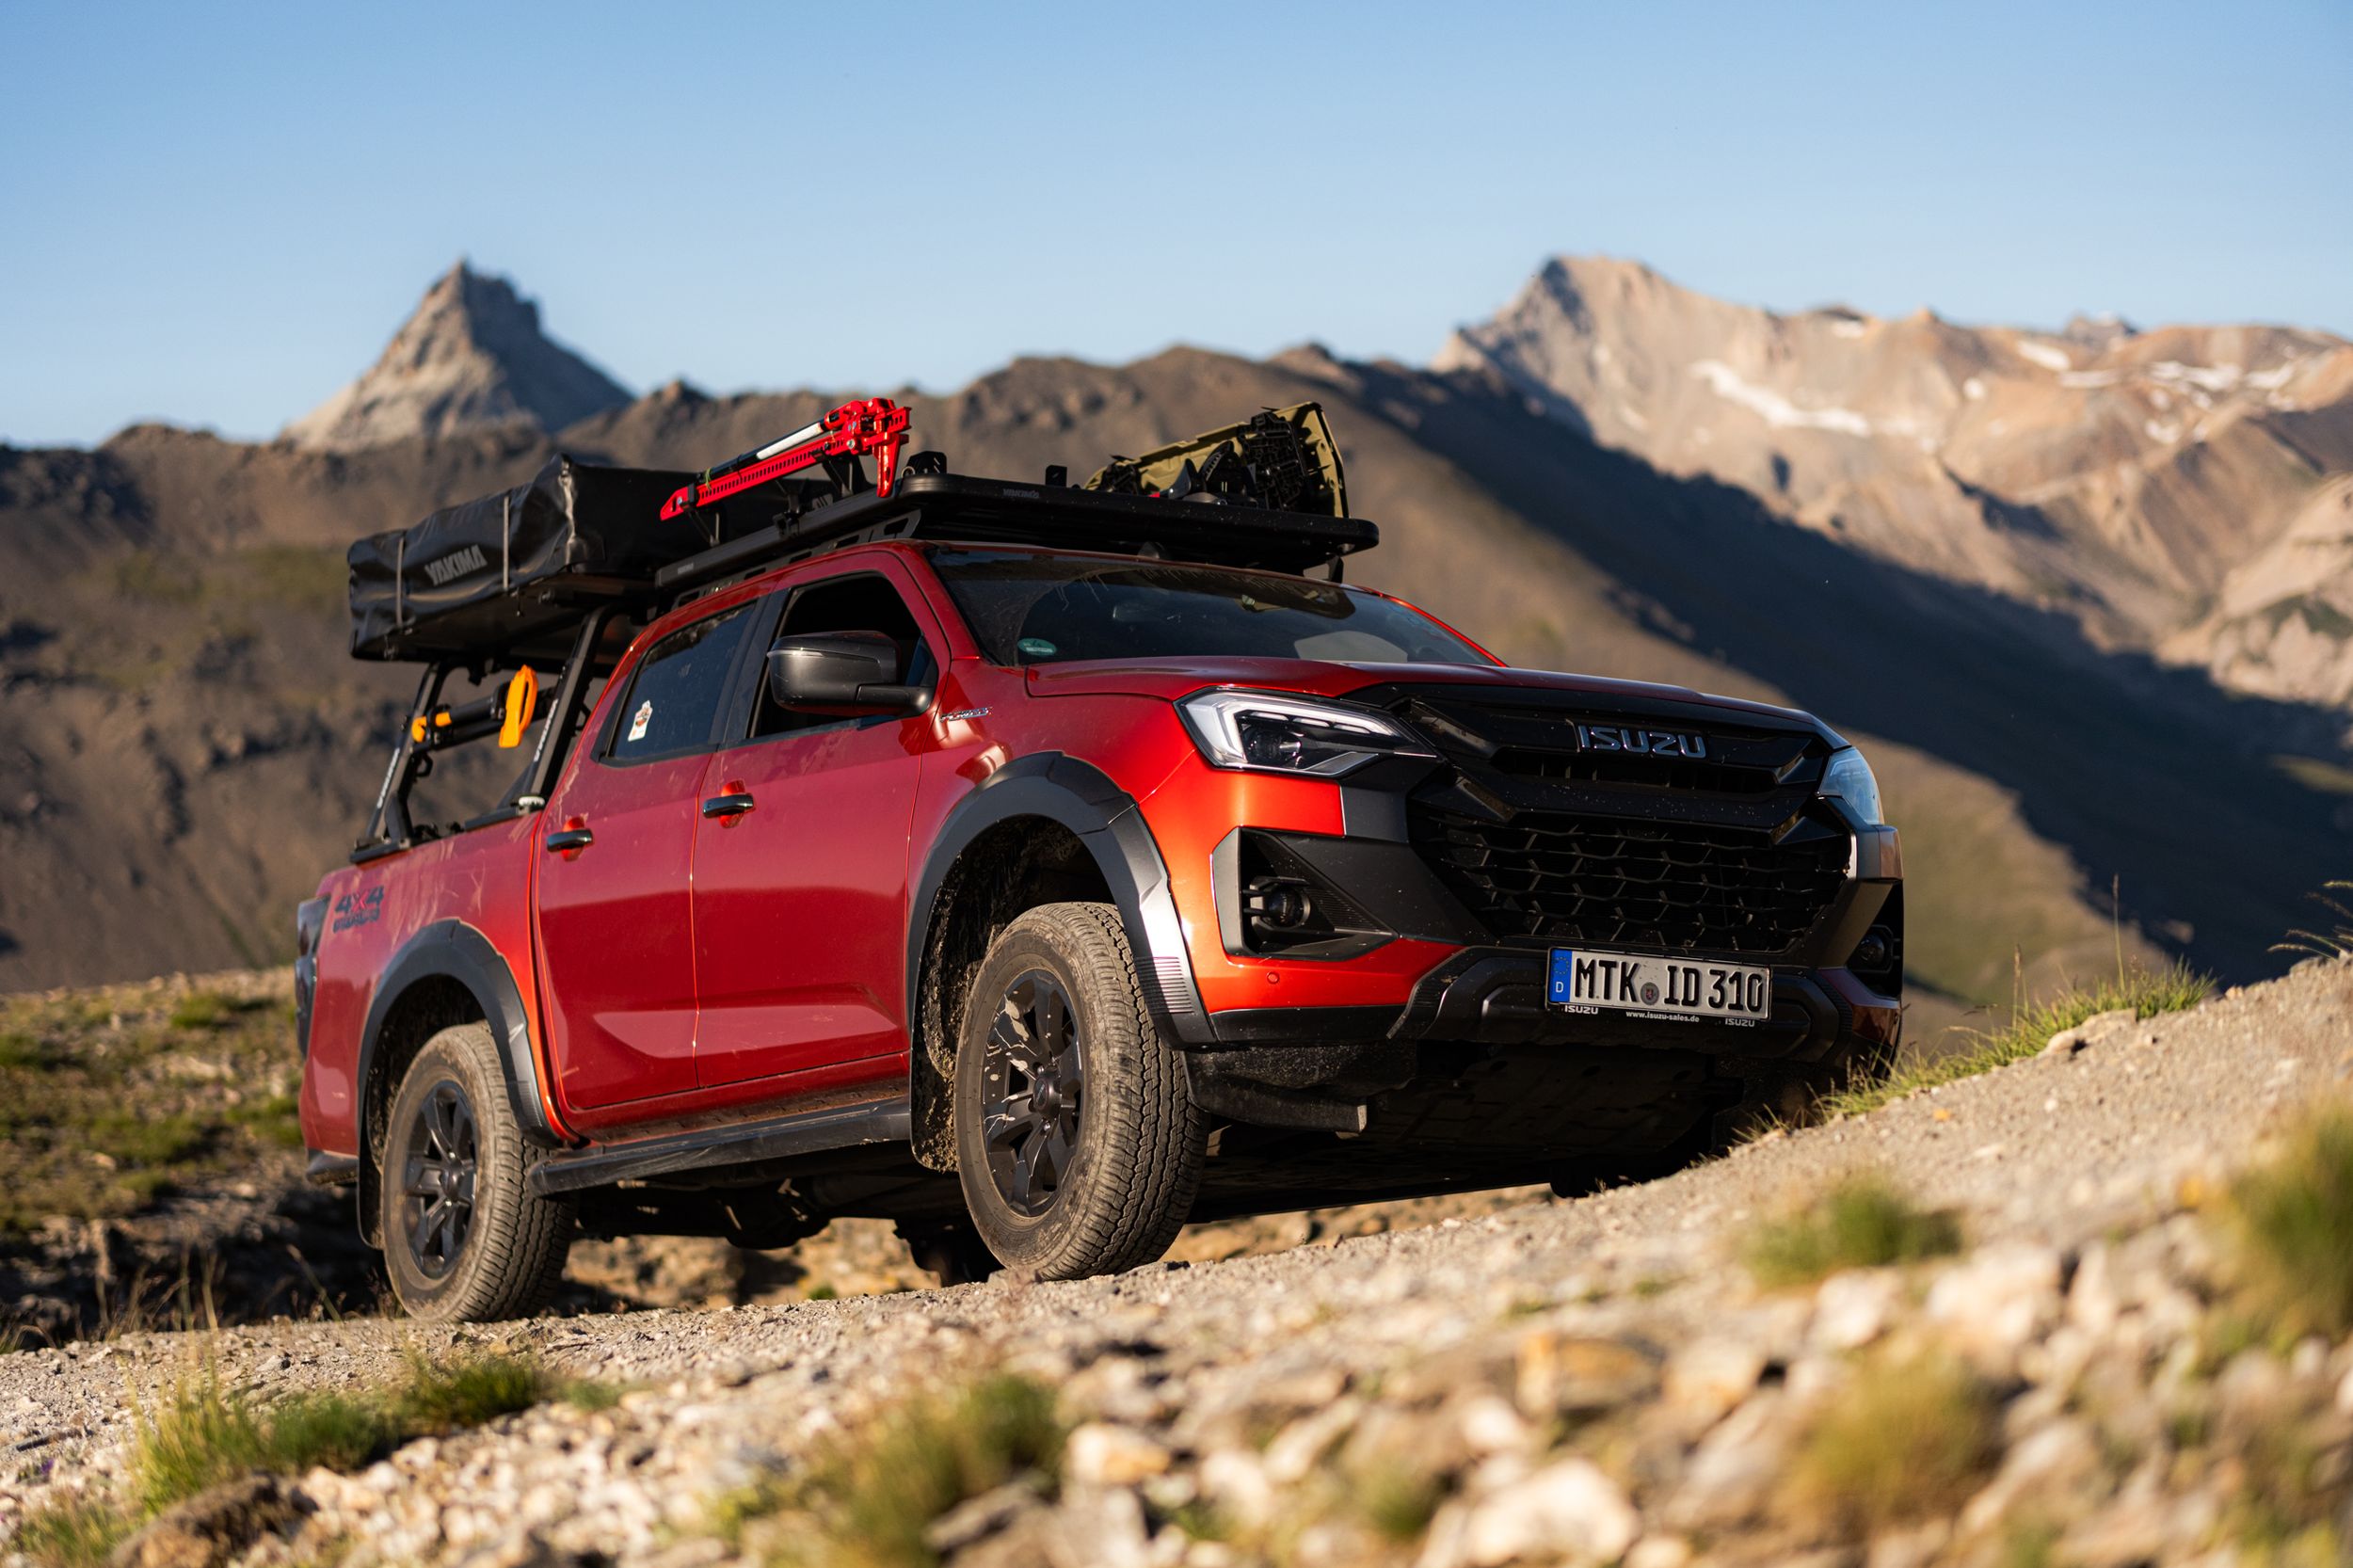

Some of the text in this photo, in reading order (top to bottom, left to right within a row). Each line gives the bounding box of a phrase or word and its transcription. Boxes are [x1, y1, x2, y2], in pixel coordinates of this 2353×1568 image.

[424, 544, 488, 585] YAKIMA
[1577, 726, 1706, 759] ISUZU
[1555, 982, 1564, 993] D
[1574, 957, 1763, 1013] MTK ID 310
[1564, 1004, 1599, 1015] ISUZU
[1625, 1011, 1700, 1023] www.isuzu-sales.de
[1724, 1017, 1755, 1028] ISUZU
